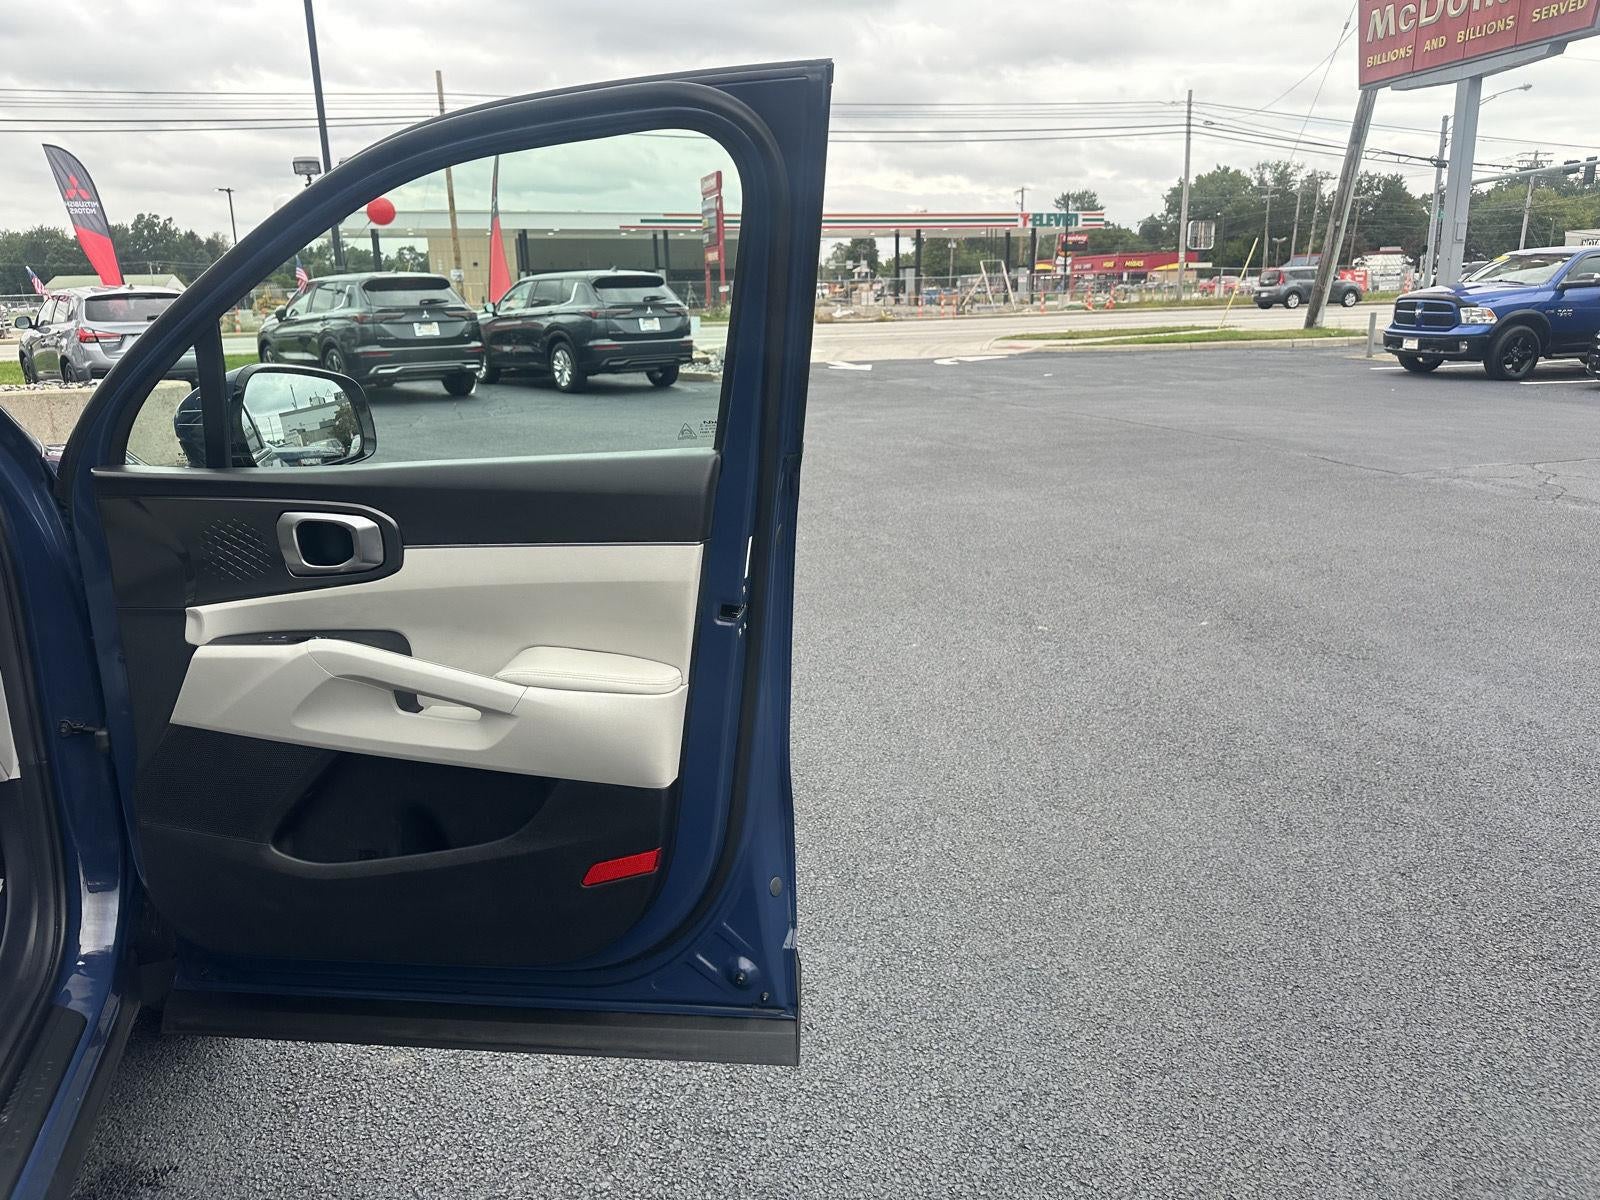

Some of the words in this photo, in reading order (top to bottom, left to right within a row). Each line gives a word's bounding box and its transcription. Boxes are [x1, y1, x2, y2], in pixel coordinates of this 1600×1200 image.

[1366, 0, 1509, 42] McDo
[1366, 45, 1413, 68] BILLIONS
[1423, 35, 1447, 53] AND
[1456, 15, 1515, 44] BILLIONS
[1531, 0, 1588, 22] SERVED
